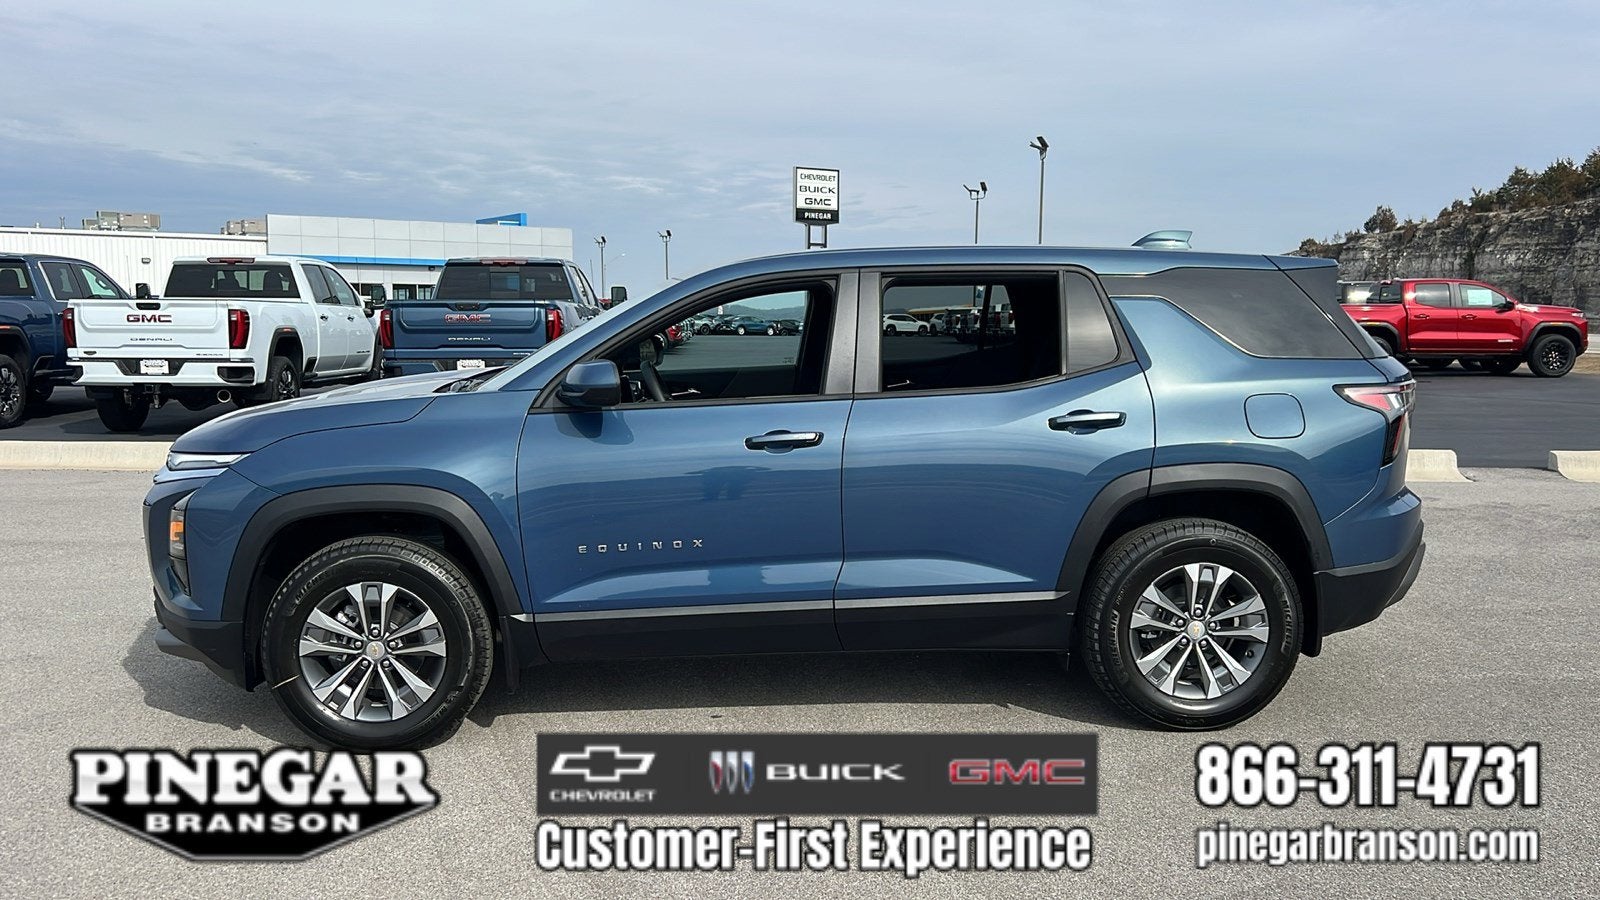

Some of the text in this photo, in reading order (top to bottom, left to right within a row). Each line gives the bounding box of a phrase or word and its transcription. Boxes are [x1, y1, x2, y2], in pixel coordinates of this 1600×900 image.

[800, 173, 836, 182] CHEVROLET
[799, 185, 836, 194] BUICK
[804, 197, 832, 206] GMC
[804, 211, 832, 220] PINEGAR
[126, 314, 173, 323] GMC
[444, 313, 492, 323] GMC
[578, 539, 703, 554] EQUINOX
